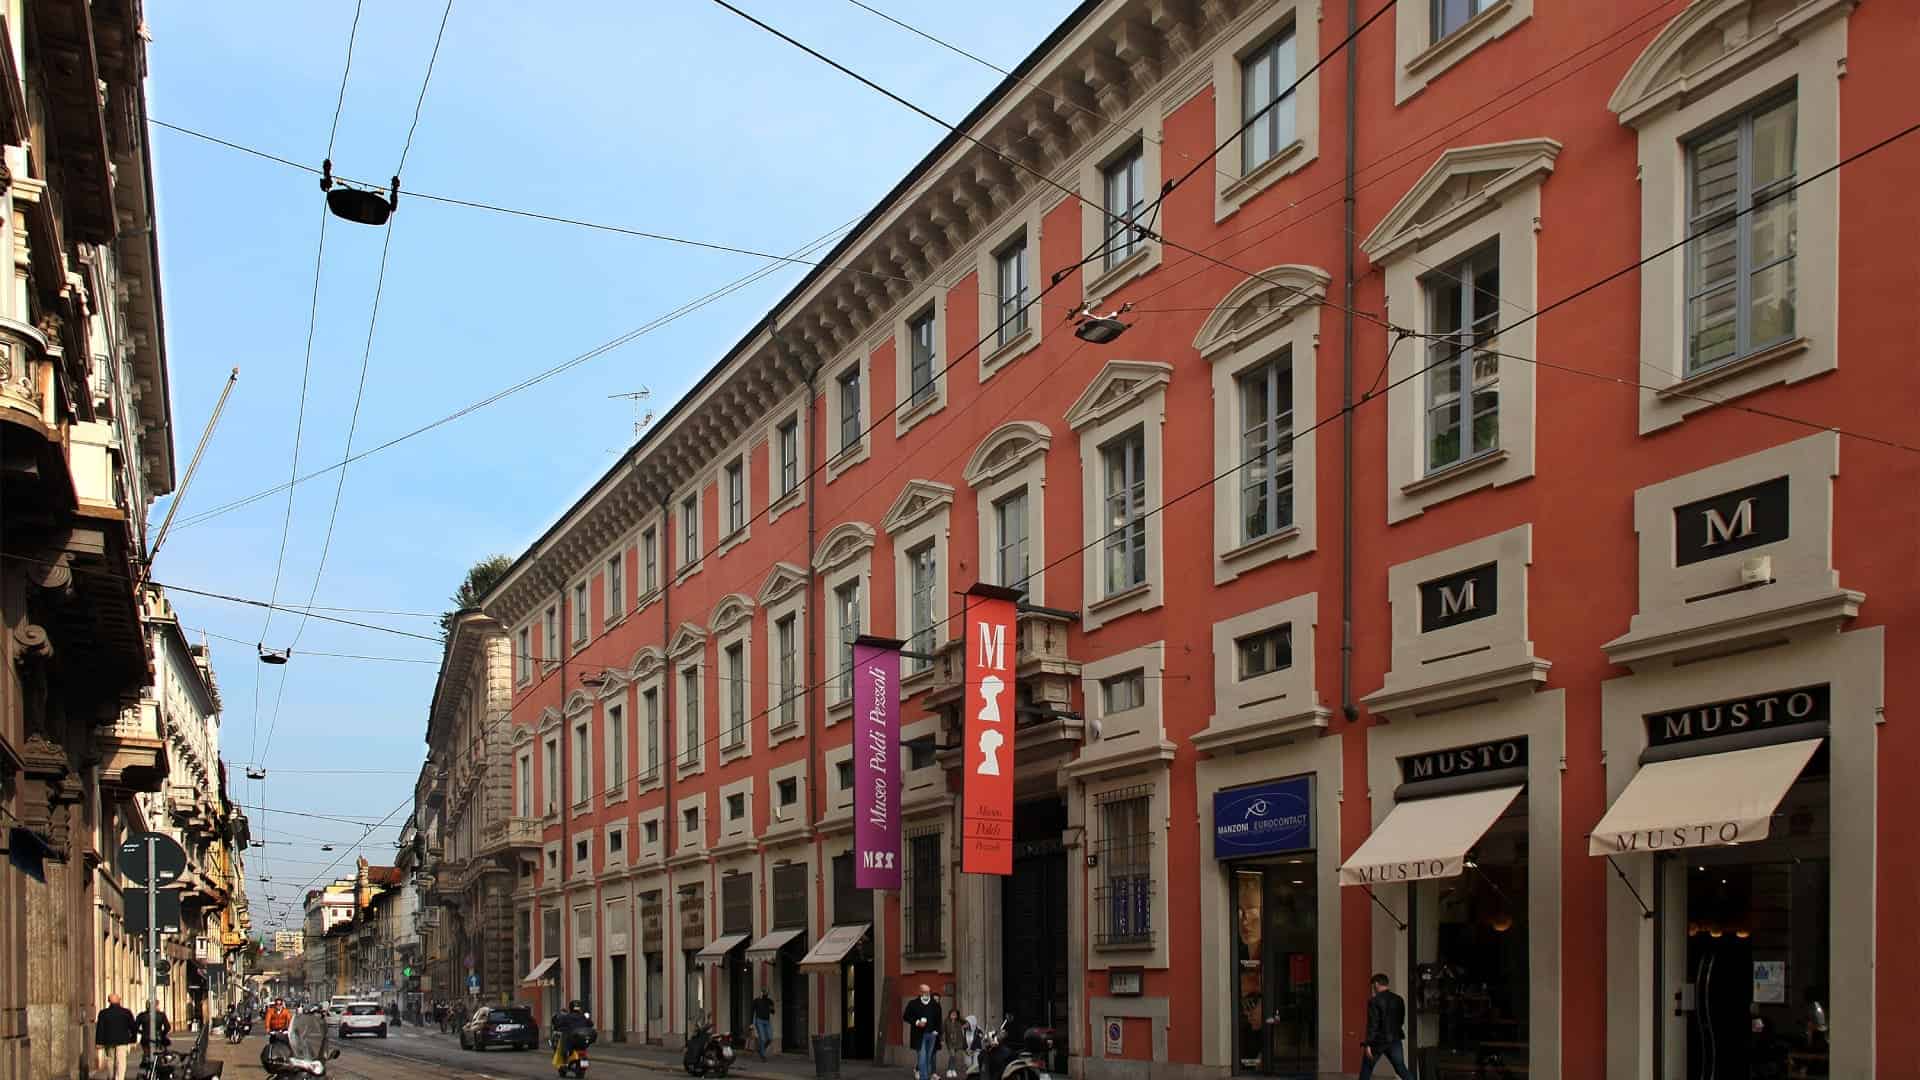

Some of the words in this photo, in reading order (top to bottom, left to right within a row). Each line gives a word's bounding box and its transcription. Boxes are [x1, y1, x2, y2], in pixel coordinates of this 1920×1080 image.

[1701, 497, 1757, 547] M
[1438, 577, 1478, 618] M
[976, 621, 1008, 671] M
[868, 665, 887, 726] Pezzoli
[1664, 692, 1813, 738] MUSTO
[869, 729, 887, 774] Poldi
[1413, 742, 1518, 777] MUSTO
[869, 778, 887, 831] Museo
[1217, 823, 1249, 834] MANZONI
[1253, 814, 1308, 831] EUROCONTACT
[1615, 822, 1739, 851] MUSTO
[1359, 860, 1444, 882] MUSTO
